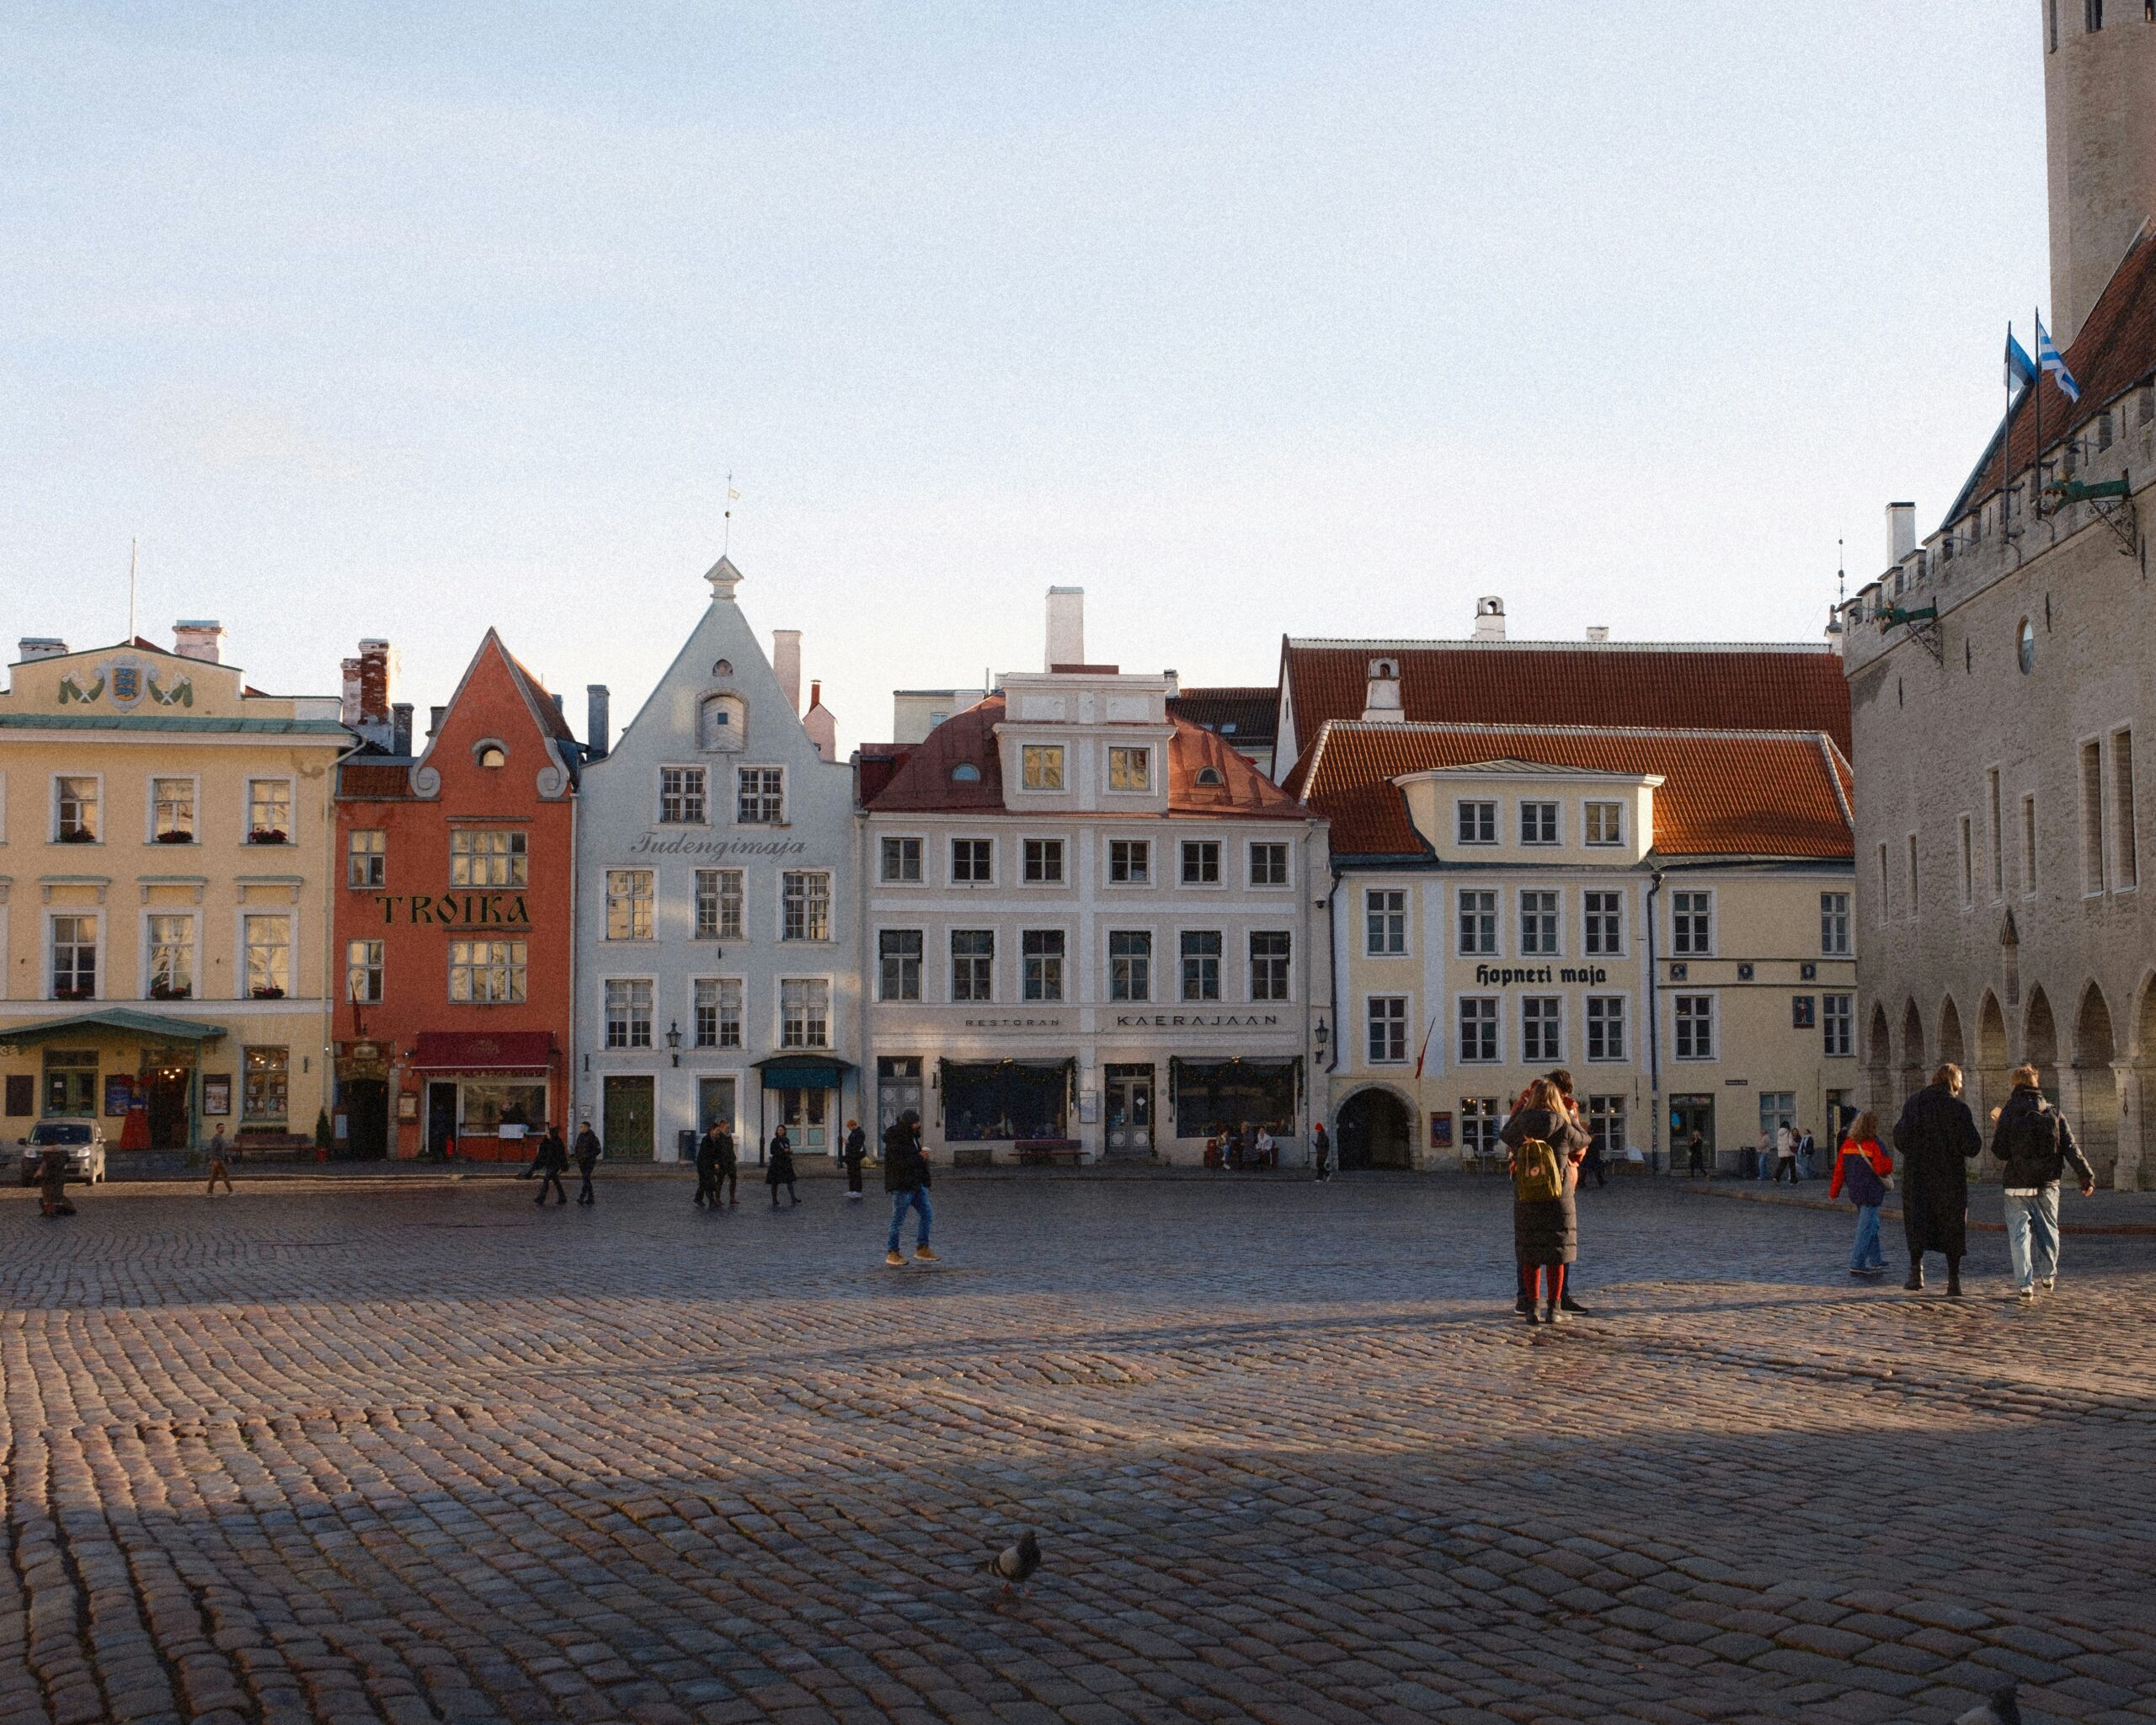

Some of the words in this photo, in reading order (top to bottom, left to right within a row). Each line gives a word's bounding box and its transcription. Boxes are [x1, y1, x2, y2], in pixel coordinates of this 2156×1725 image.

[632, 831, 807, 863] Tudengimaja
[376, 893, 531, 924] TROIKA
[1476, 964, 1552, 986] Hopneri
[1561, 964, 1607, 986] maja
[1118, 1015, 1277, 1026] KAERAJAAN
